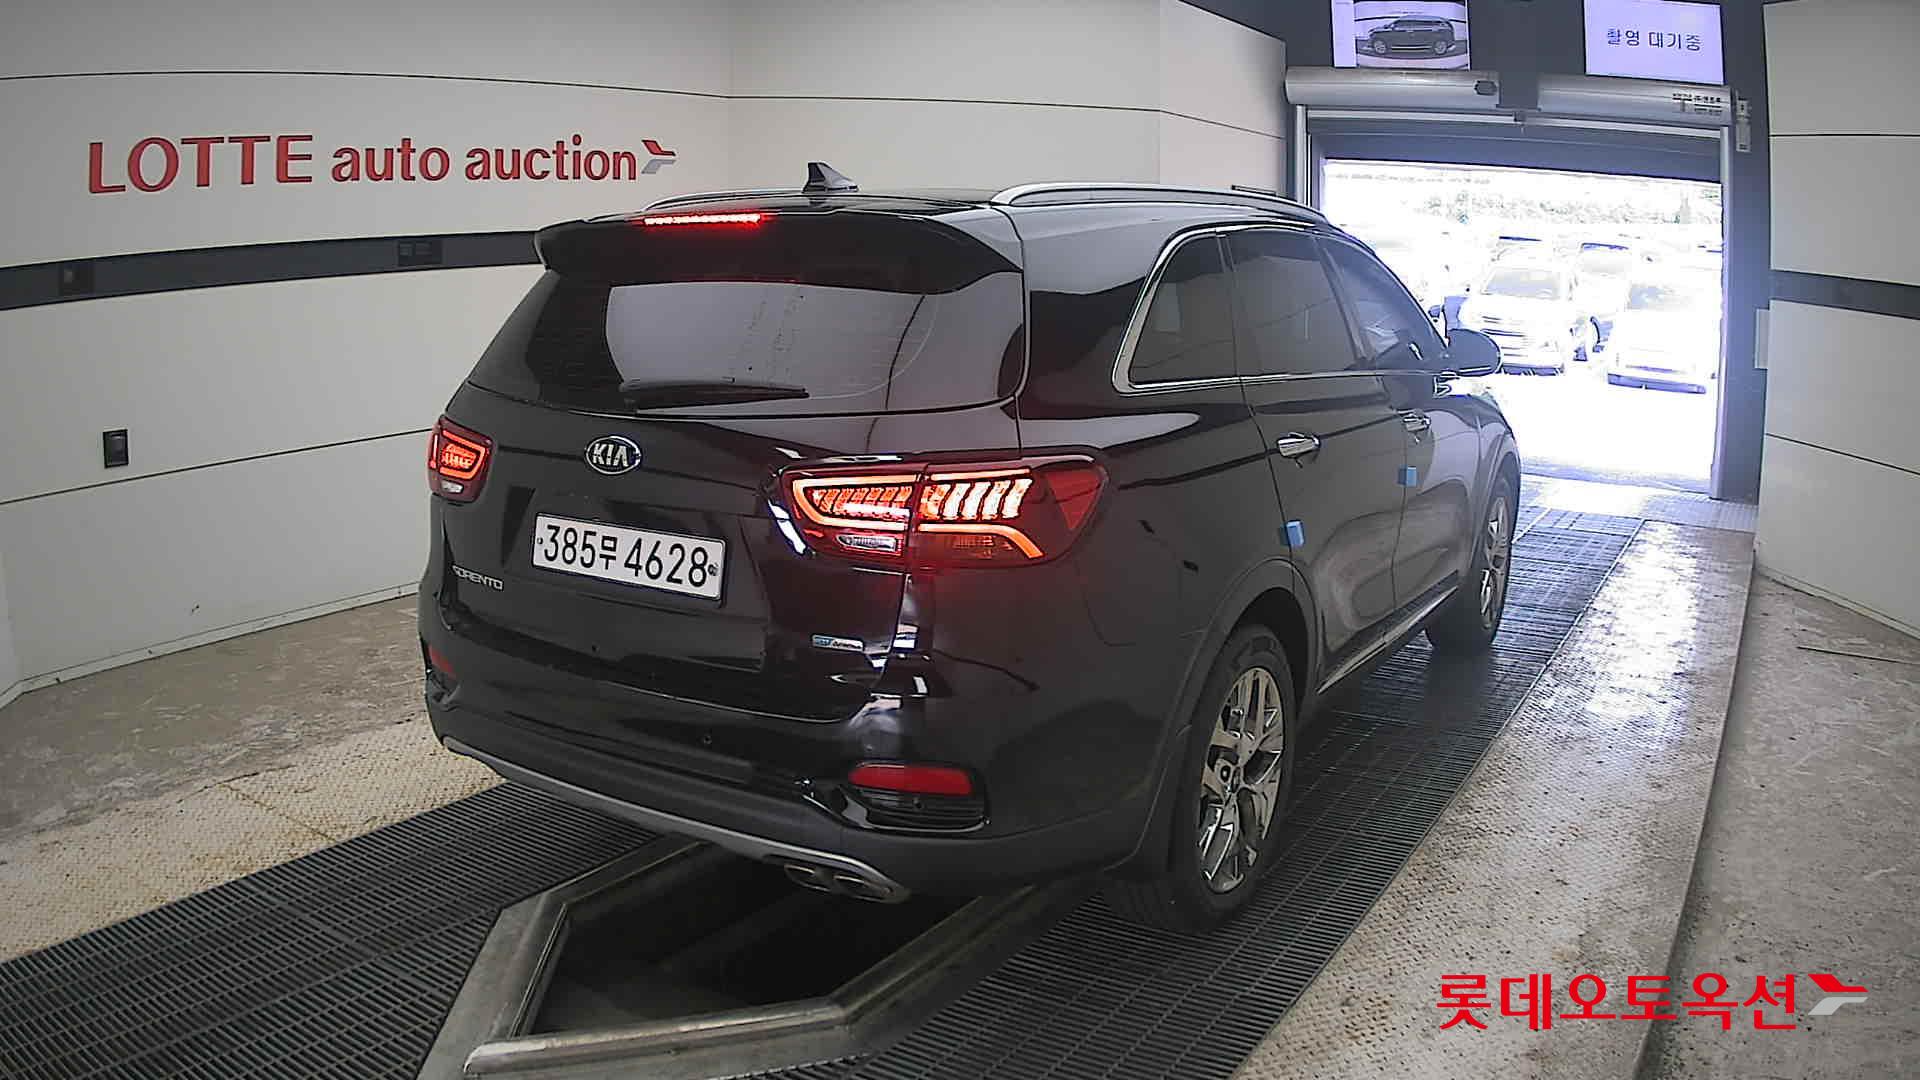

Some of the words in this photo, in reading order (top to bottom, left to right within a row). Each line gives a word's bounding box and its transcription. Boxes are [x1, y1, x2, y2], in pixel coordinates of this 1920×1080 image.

[1648, 31, 1702, 52] 대기중
[89, 134, 313, 194] LOTTE
[331, 137, 450, 182] auto
[465, 134, 638, 181] auction
[592, 443, 629, 467] KIA
[544, 524, 618, 570] 385무
[624, 537, 709, 587] 4628
